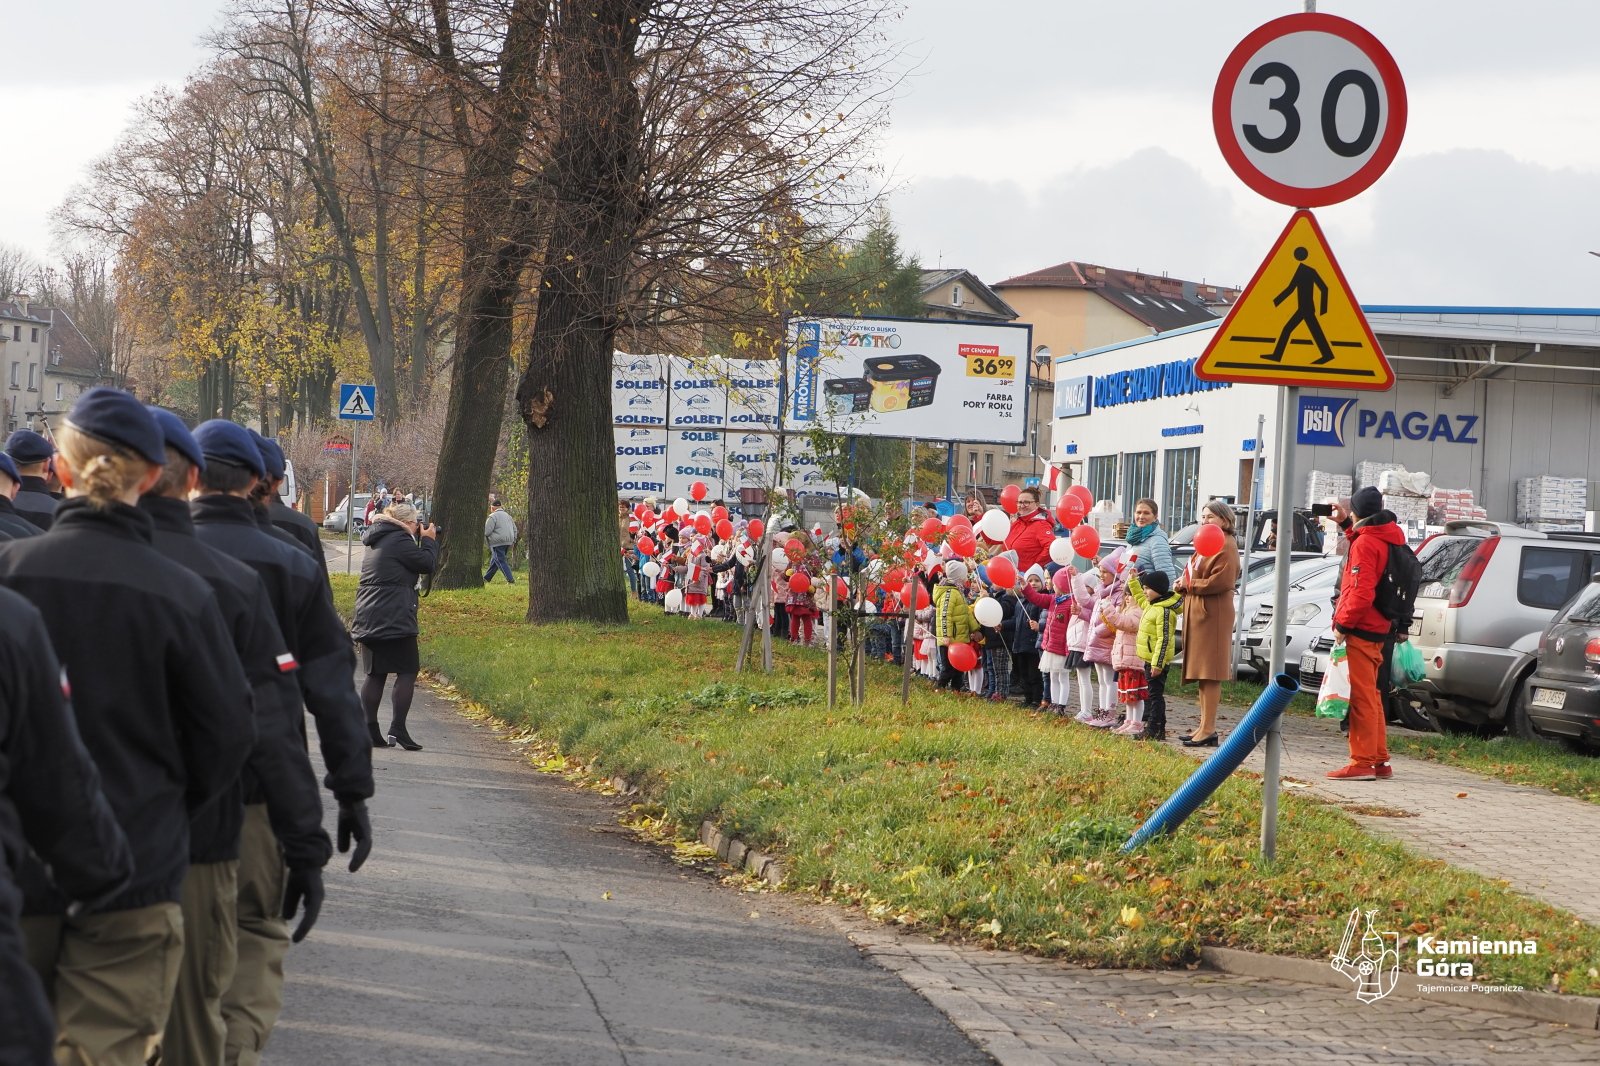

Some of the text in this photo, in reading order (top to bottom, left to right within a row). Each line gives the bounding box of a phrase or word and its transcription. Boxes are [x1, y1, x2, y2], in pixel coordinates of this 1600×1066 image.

[1242, 62, 1380, 157] 30
[615, 380, 664, 389] SOLBET
[986, 393, 1013, 401] FARBA
[989, 402, 1013, 410] ROKU
[614, 415, 664, 424] SOLBET
[675, 415, 723, 424] SOLBET
[1302, 405, 1333, 434] psb
[1358, 409, 1479, 444] PAGAZ
[615, 445, 666, 456] SOLBET
[615, 481, 664, 492] SOLBET
